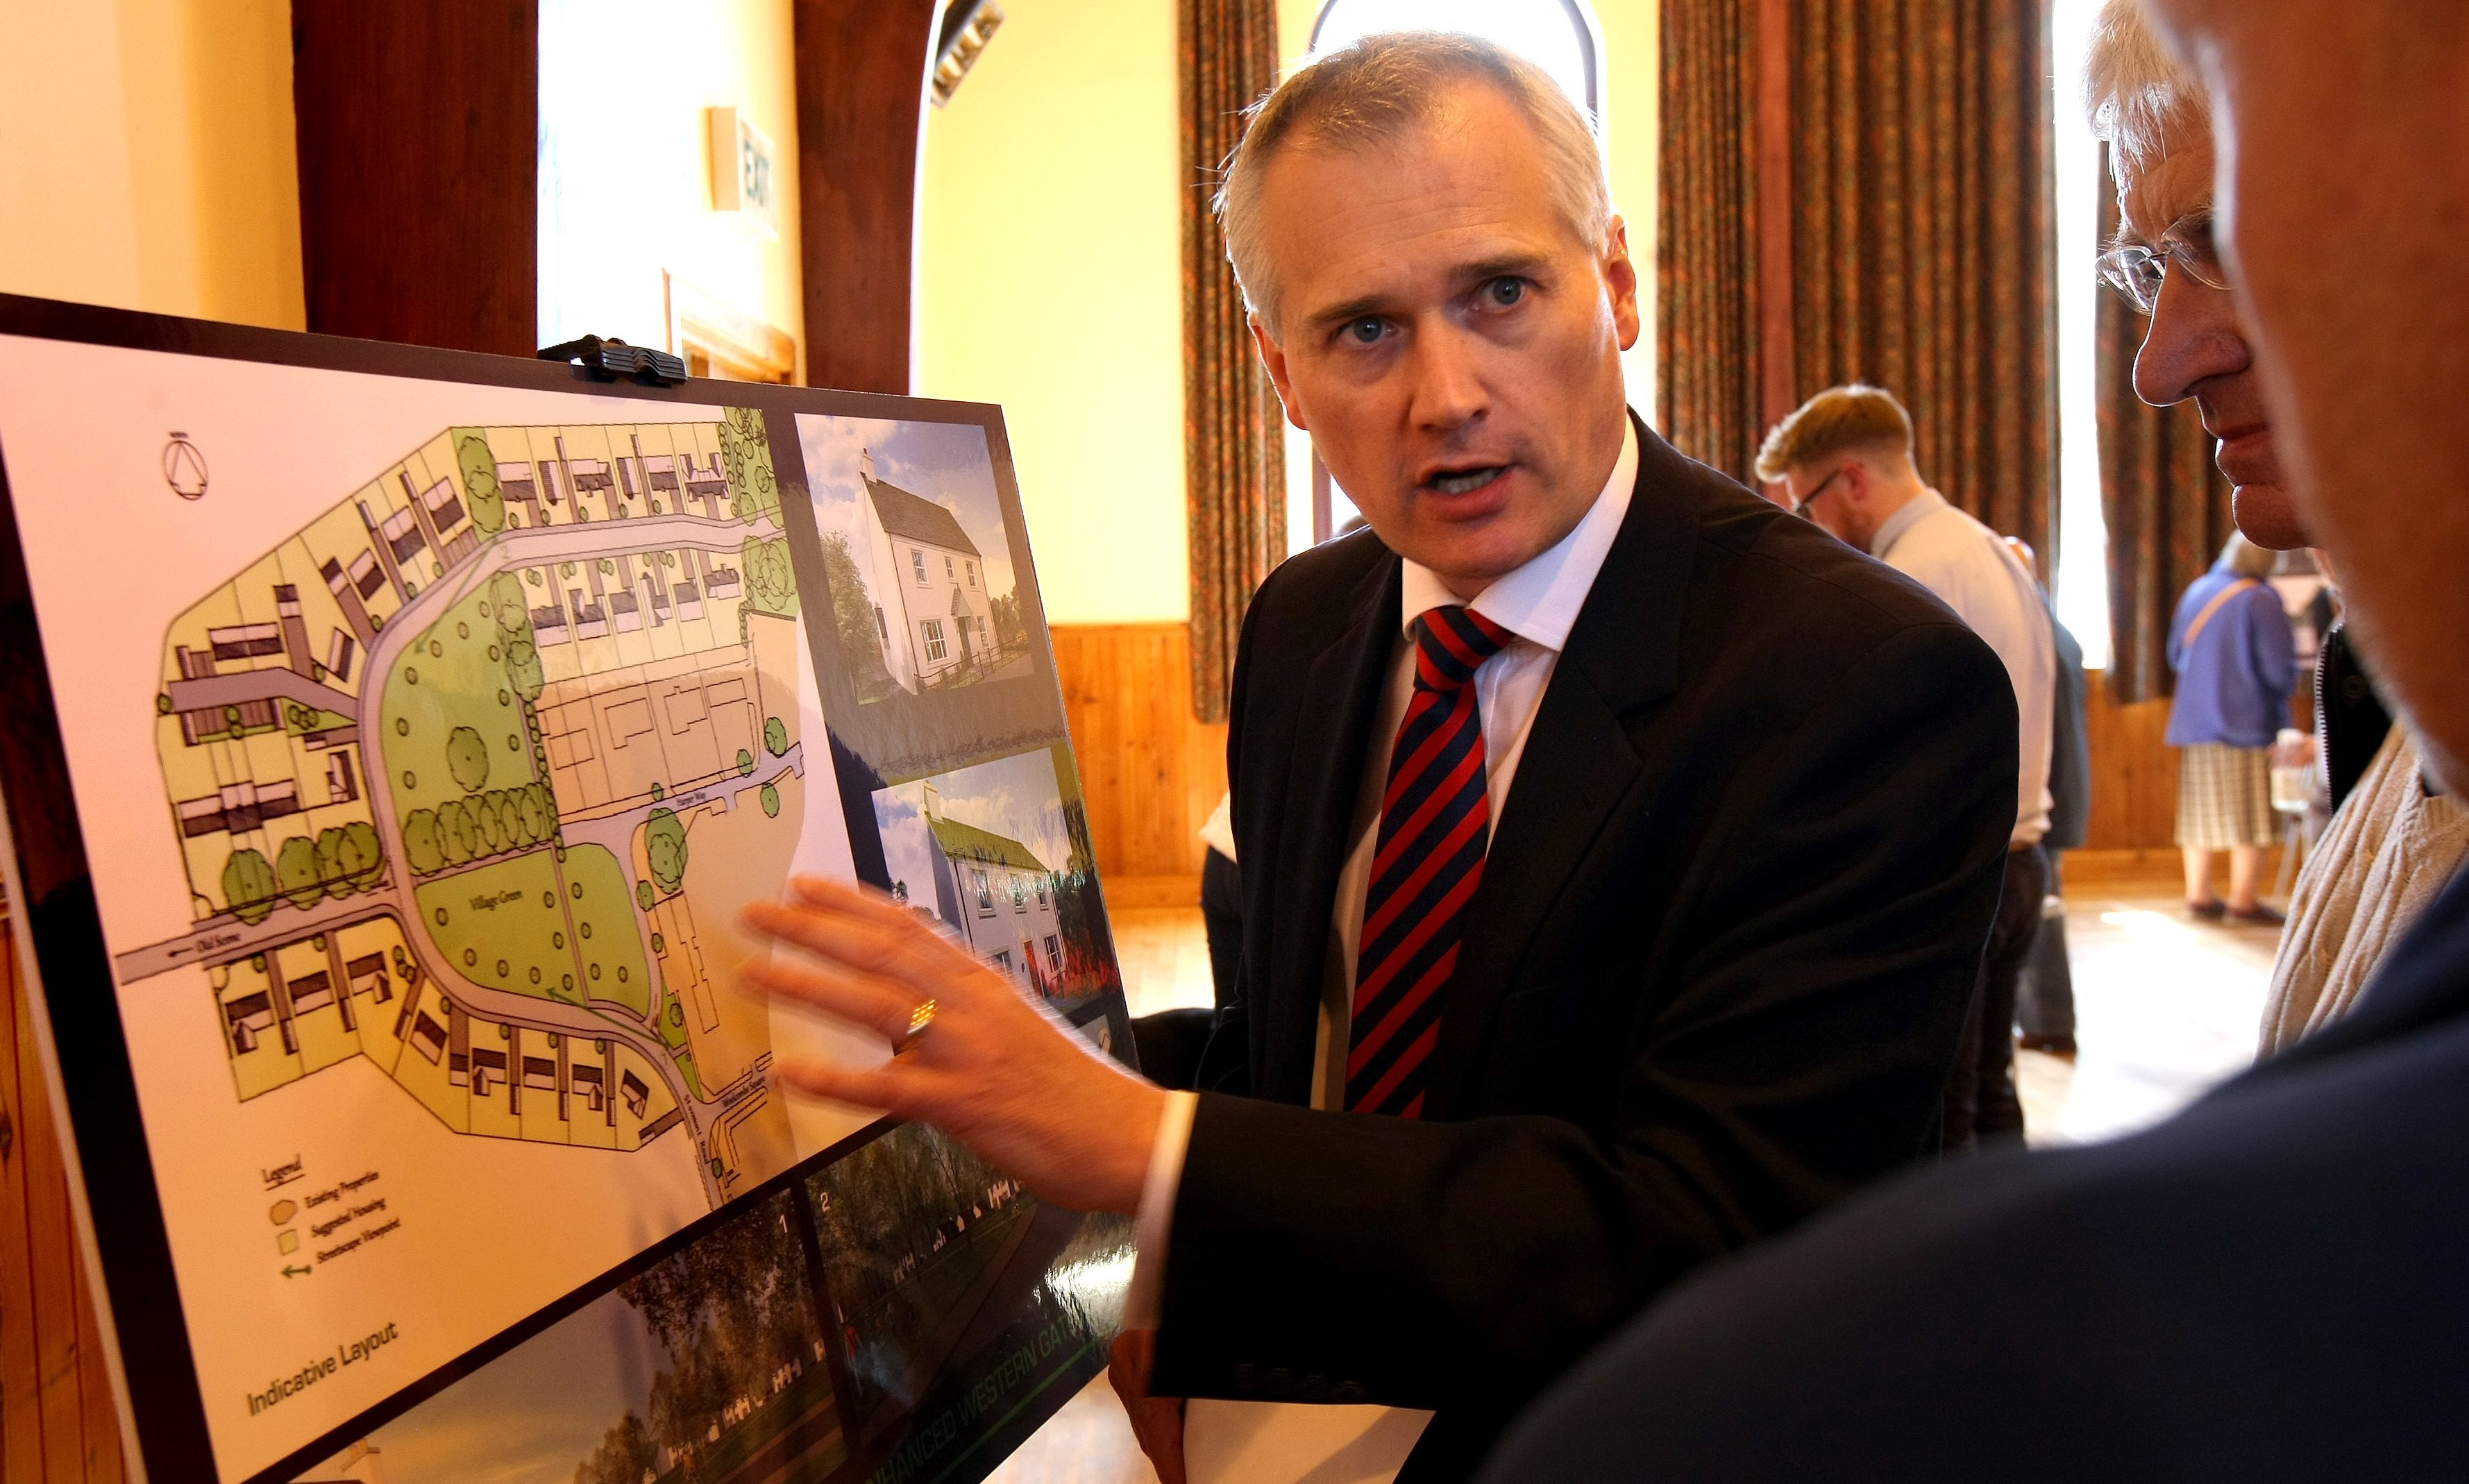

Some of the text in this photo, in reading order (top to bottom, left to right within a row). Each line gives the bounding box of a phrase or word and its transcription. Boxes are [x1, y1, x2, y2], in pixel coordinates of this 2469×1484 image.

[469, 891, 523, 911] Village Green
[700, 1140, 710, 1164] Road
[262, 1153, 303, 1185] Legend
[304, 1172, 379, 1208] Existing Properties
[820, 1192, 831, 1212] 2
[311, 1198, 387, 1238] Suggested Housing
[361, 1217, 402, 1241] Viewpoint
[779, 1214, 788, 1233] 1
[246, 1322, 399, 1417] Indicative Layout
[957, 1338, 1038, 1427] WESTERN
[1038, 1313, 1071, 1358] GAT
